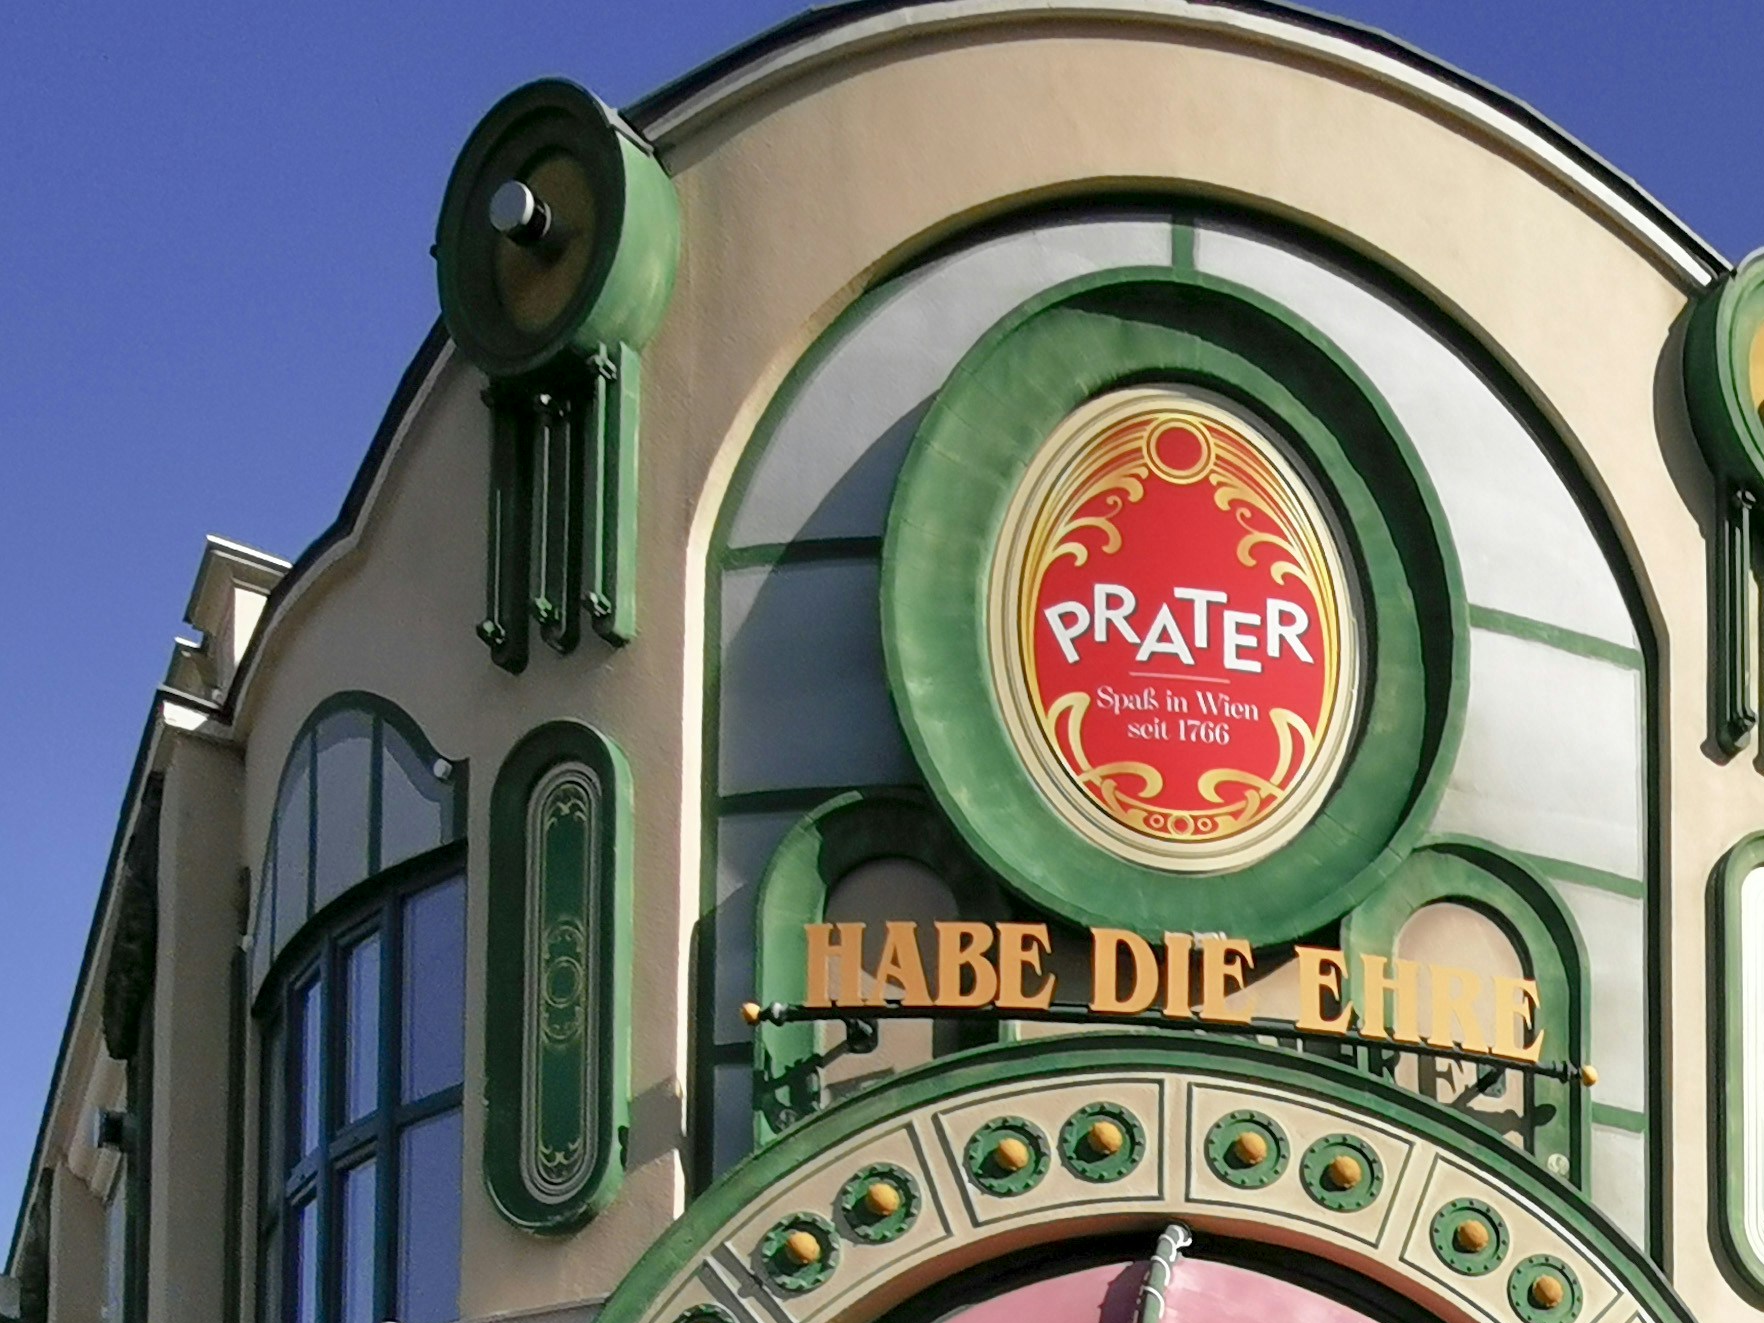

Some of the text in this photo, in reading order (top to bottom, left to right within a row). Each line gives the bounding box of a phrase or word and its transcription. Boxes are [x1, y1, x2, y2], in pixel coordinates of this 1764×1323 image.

[1043, 583, 1315, 674] PRATER
[1096, 685, 1259, 721] Spaß in Wien
[1127, 717, 1231, 745] seit 1766
[804, 921, 1546, 1063] HABE DIE EHRE
